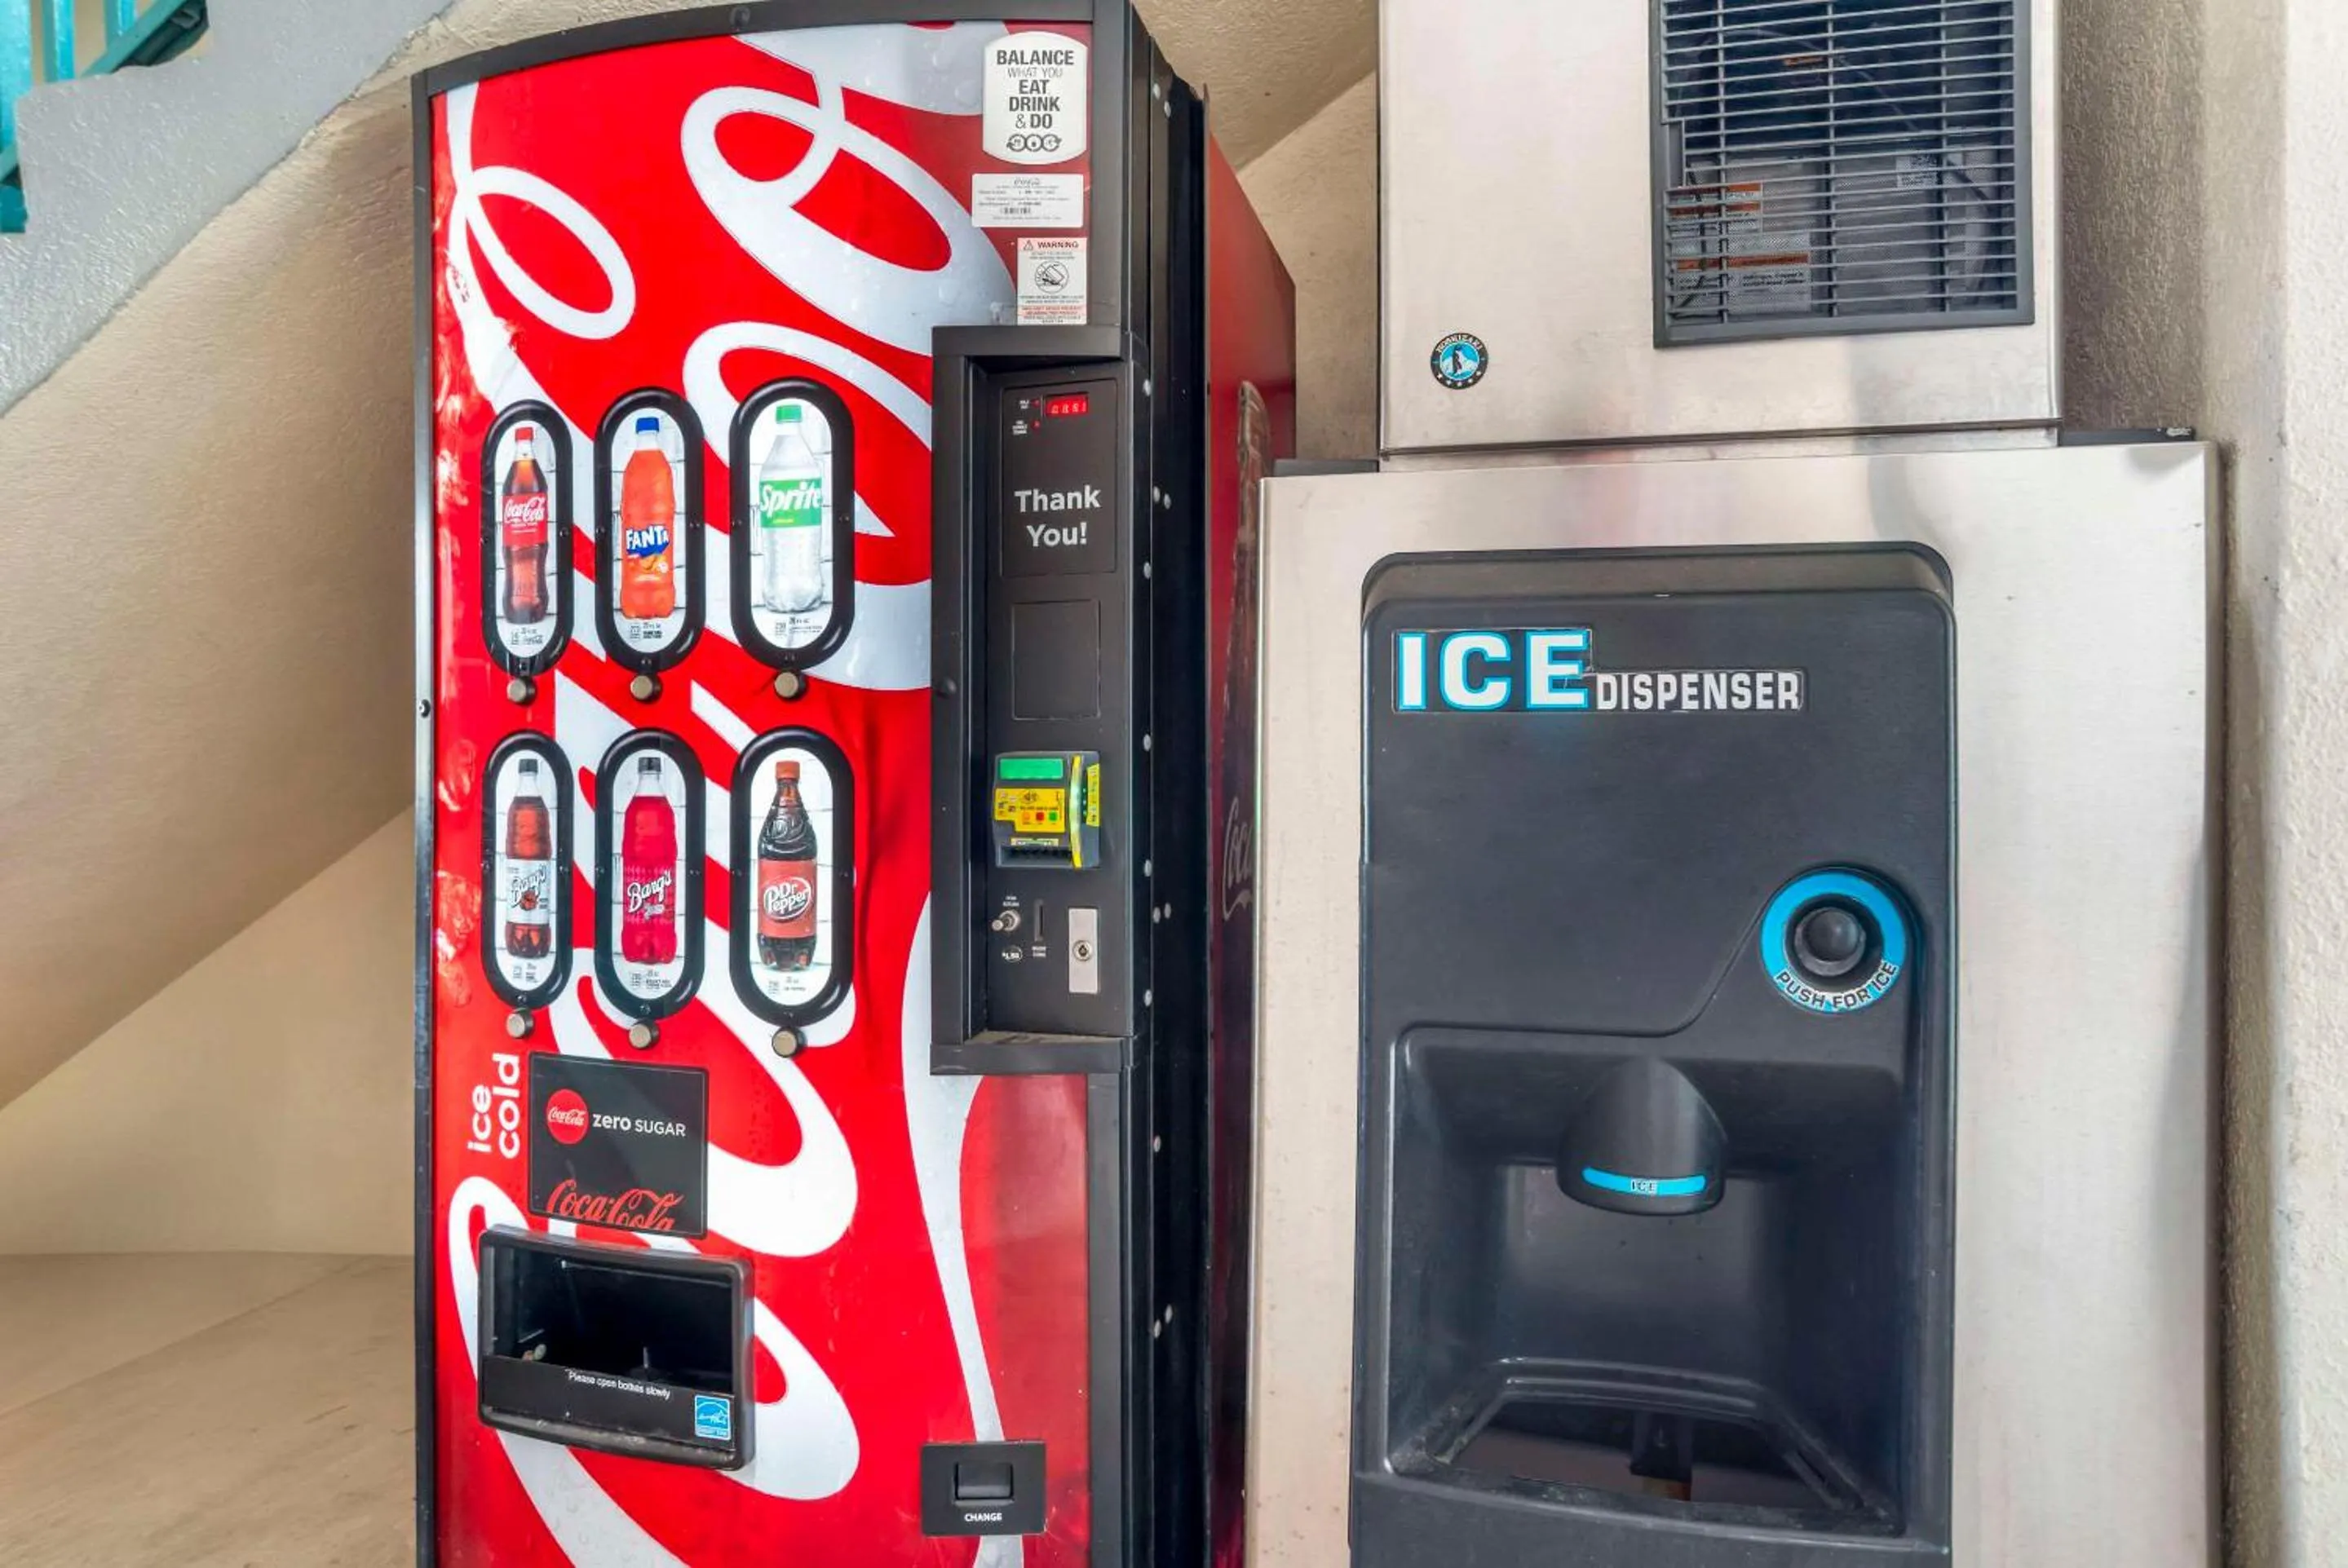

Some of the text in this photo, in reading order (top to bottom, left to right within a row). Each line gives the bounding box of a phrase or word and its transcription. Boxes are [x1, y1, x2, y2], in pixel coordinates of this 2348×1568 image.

[996, 50, 1075, 65] BALANCE
[1007, 67, 1063, 78] WHAT YOU
[1019, 79, 1050, 95] EAT
[1009, 96, 1061, 112] DRINK
[1015, 113, 1053, 129] & DO
[1014, 484, 1102, 512] Thank
[626, 525, 670, 550] FANTA
[1026, 521, 1088, 547] You!
[1398, 630, 1800, 710] ICE DISPENSER
[766, 885, 811, 915] Pepper
[779, 881, 798, 898] Dr
[1775, 961, 1898, 1009] PUSH FOR ICE
[467, 1084, 492, 1153] ice
[492, 1053, 520, 1159] cold
[592, 1113, 631, 1132] zero
[635, 1120, 687, 1137] SUGAR
[1632, 1181, 1656, 1191] ICE
[546, 1179, 684, 1230] Coca-Cola
[568, 1370, 670, 1401] Please open bottles slowly
[963, 1513, 1003, 1522] CHANGE
